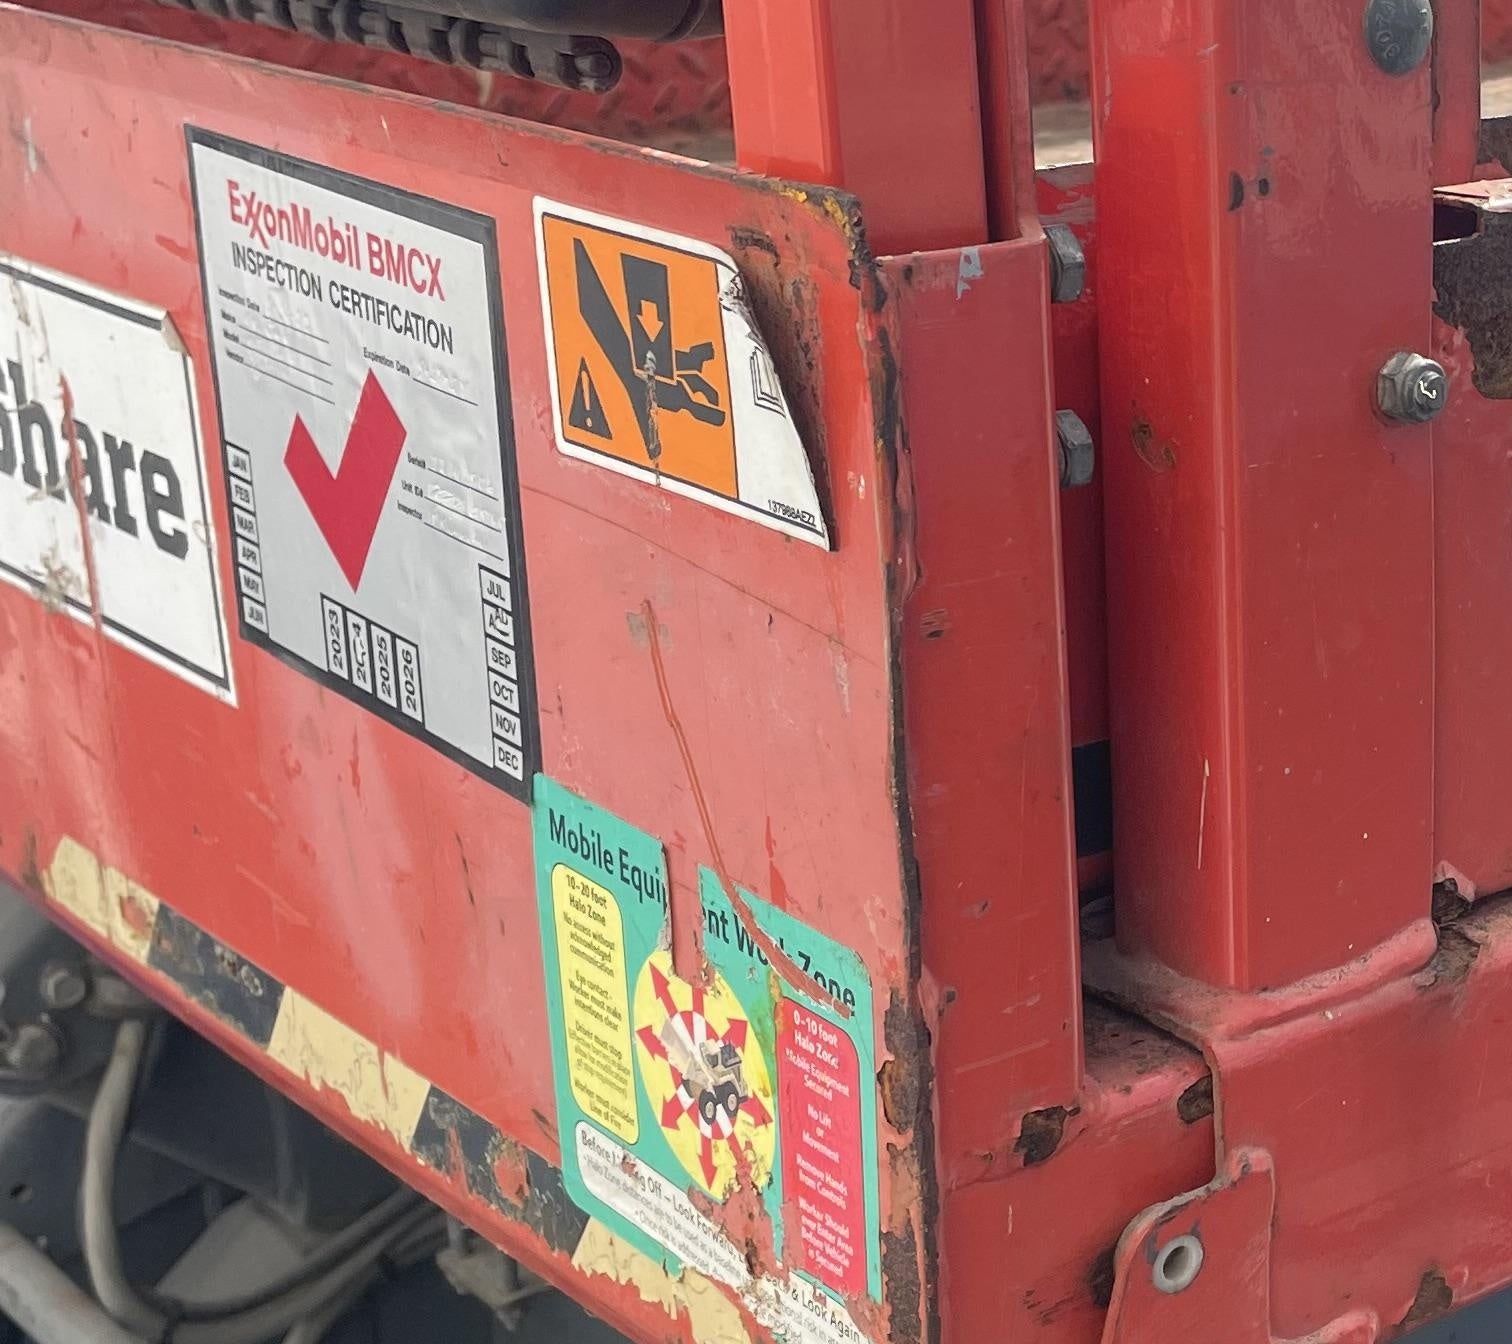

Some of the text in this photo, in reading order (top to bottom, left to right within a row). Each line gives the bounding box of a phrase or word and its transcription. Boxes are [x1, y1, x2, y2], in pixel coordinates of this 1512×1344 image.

[227, 179, 445, 301] ExxonMobil BMCX
[231, 241, 323, 302] INSPECTION
[329, 280, 453, 354] CERTIFICATION
[231, 453, 247, 473] JAN
[234, 484, 250, 504] FEB
[237, 514, 254, 534] MAR
[487, 580, 506, 602] JUL
[328, 609, 343, 670] 2023
[376, 636, 391, 698] 2025
[491, 647, 511, 668] SEP
[401, 648, 416, 713] 2026
[493, 681, 514, 703] OCT
[495, 713, 516, 736] NOV
[498, 746, 518, 770] DEC
[548, 808, 613, 875] Mobile
[569, 893, 606, 927] Halo Zone
[591, 888, 607, 909] foot
[795, 1030, 815, 1054] Halo
[818, 1023, 838, 1048] foot
[811, 1064, 849, 1097] Equipment
[807, 1104, 819, 1121] No
[673, 1193, 695, 1225] Look
